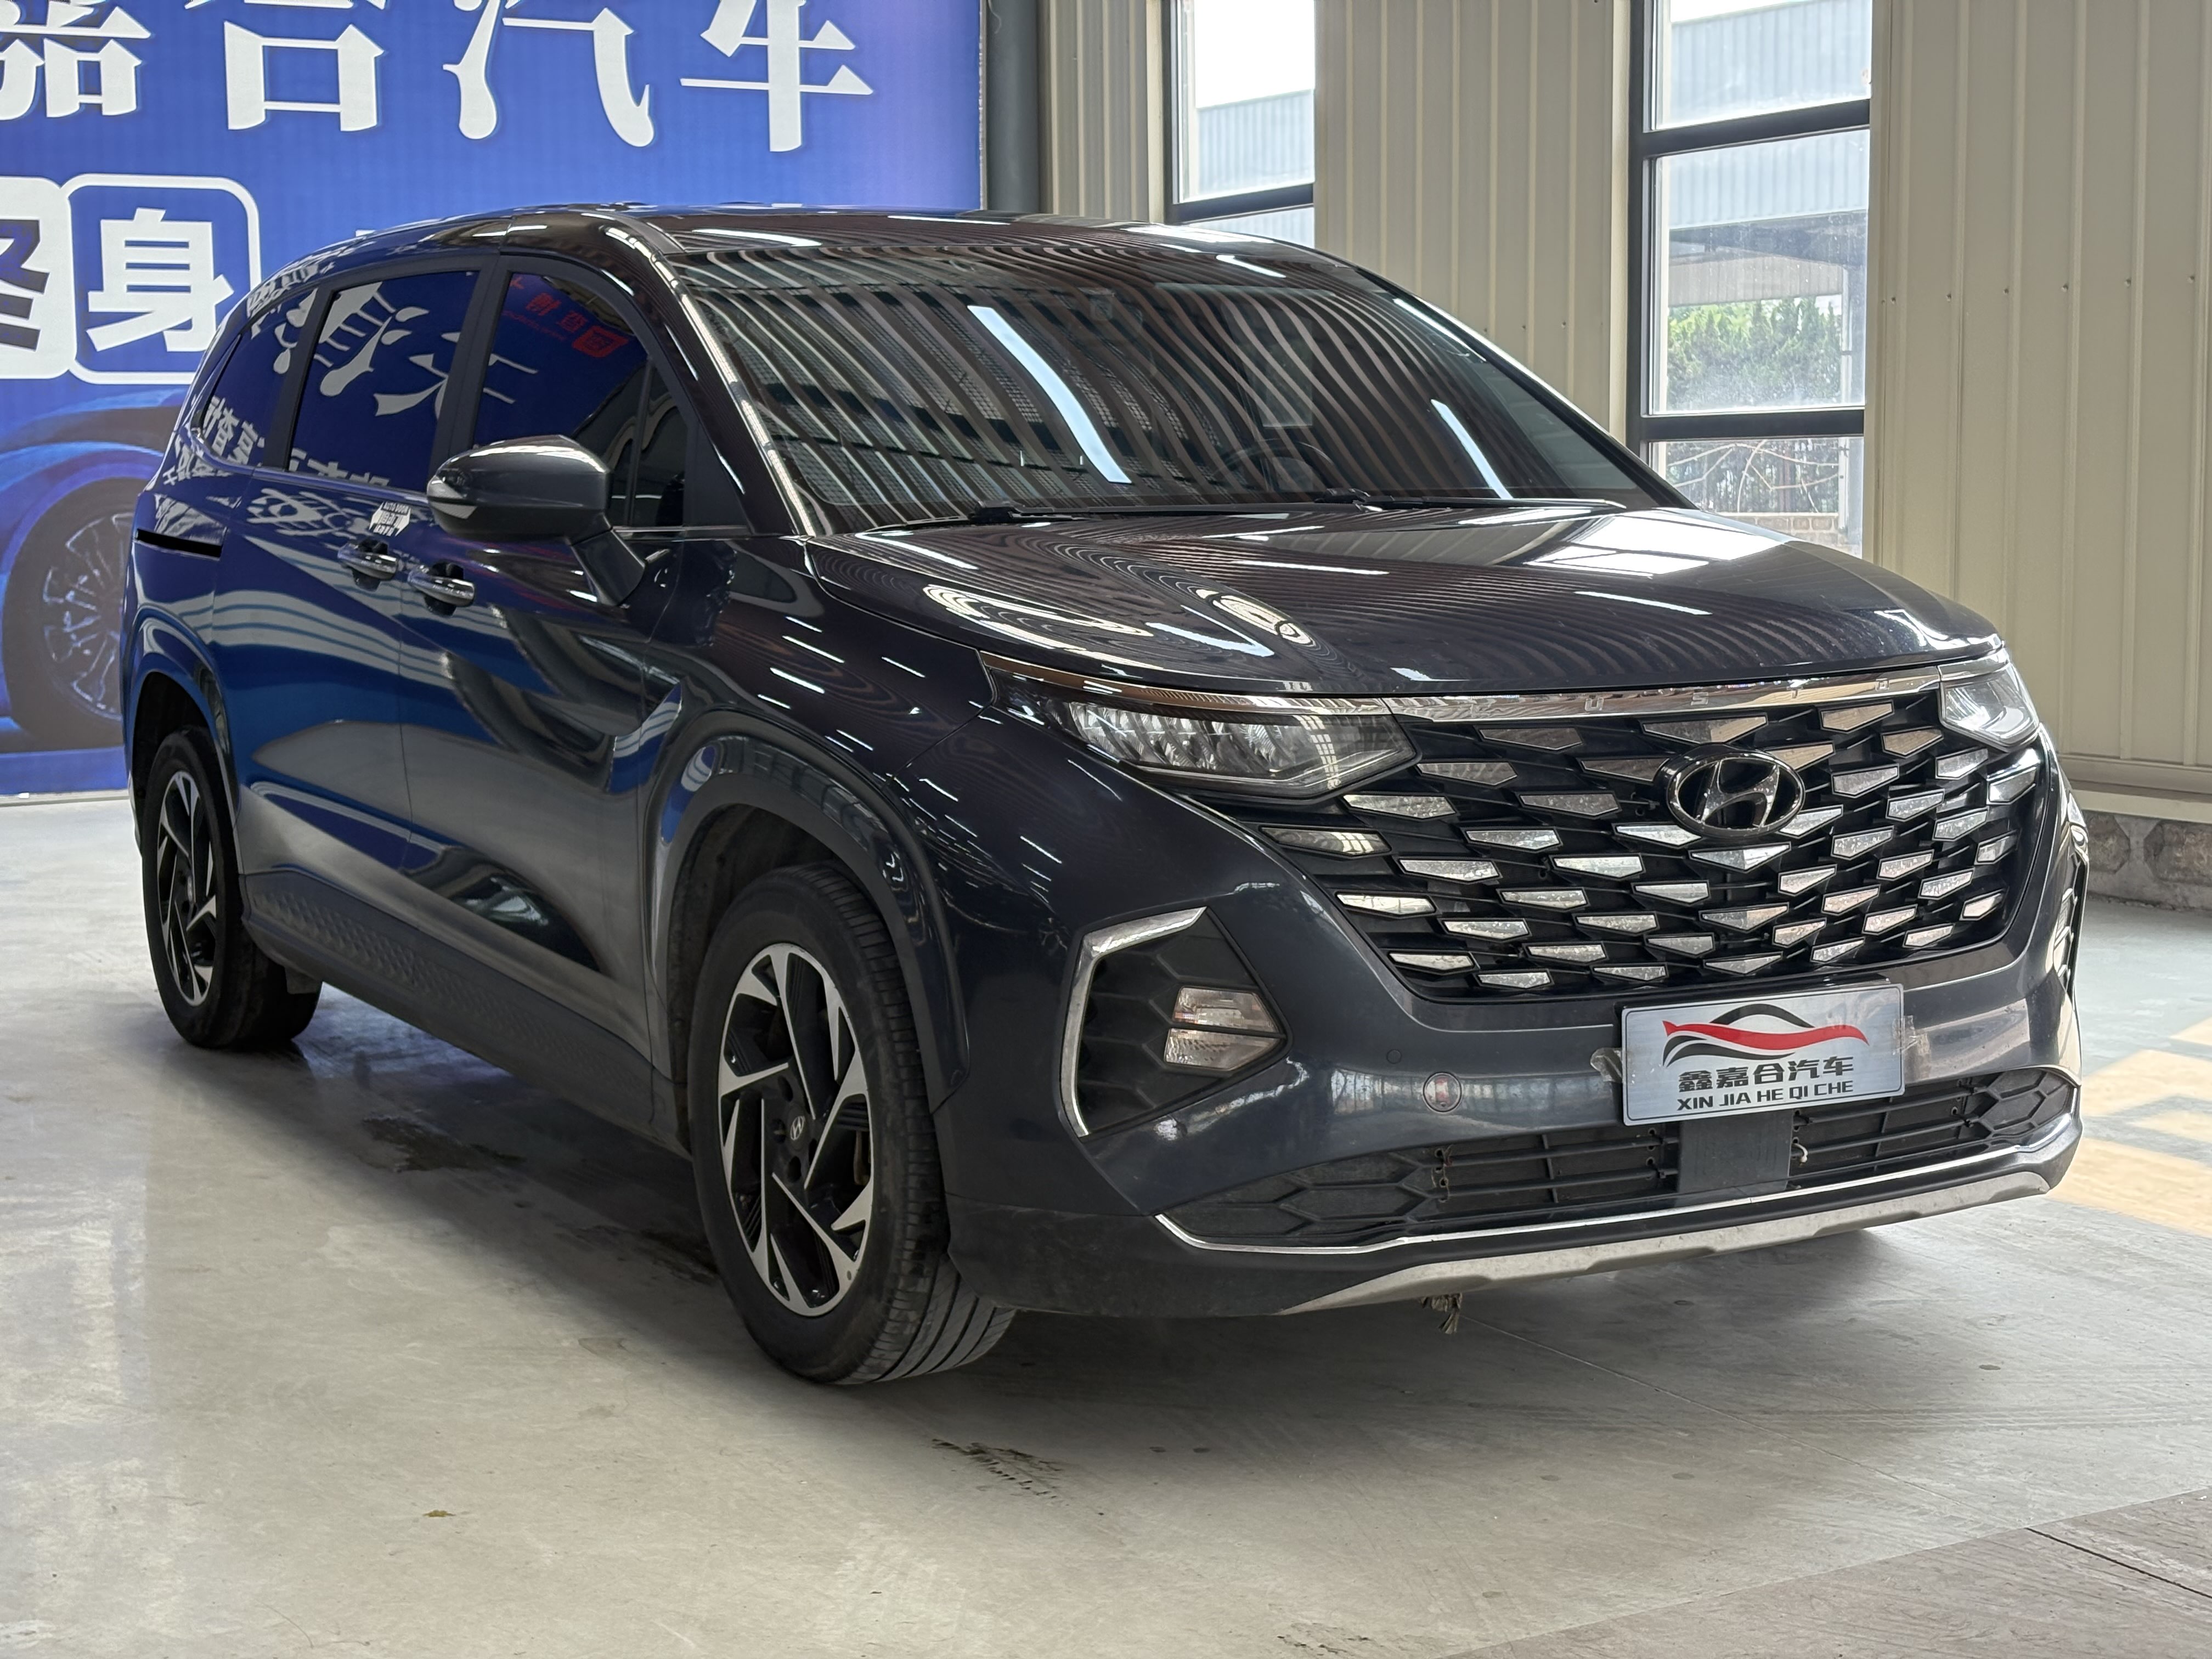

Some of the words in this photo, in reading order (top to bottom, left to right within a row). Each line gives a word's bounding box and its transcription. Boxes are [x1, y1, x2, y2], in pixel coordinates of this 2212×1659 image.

[1678, 1056, 1854, 1093] 鑫嘉合汽车
[1677, 1096, 1713, 1111] XIN
[1719, 1092, 1752, 1107] JIA
[1757, 1088, 1784, 1103] HE
[1789, 1085, 1808, 1100] QI
[1814, 1080, 1854, 1096] CHE
